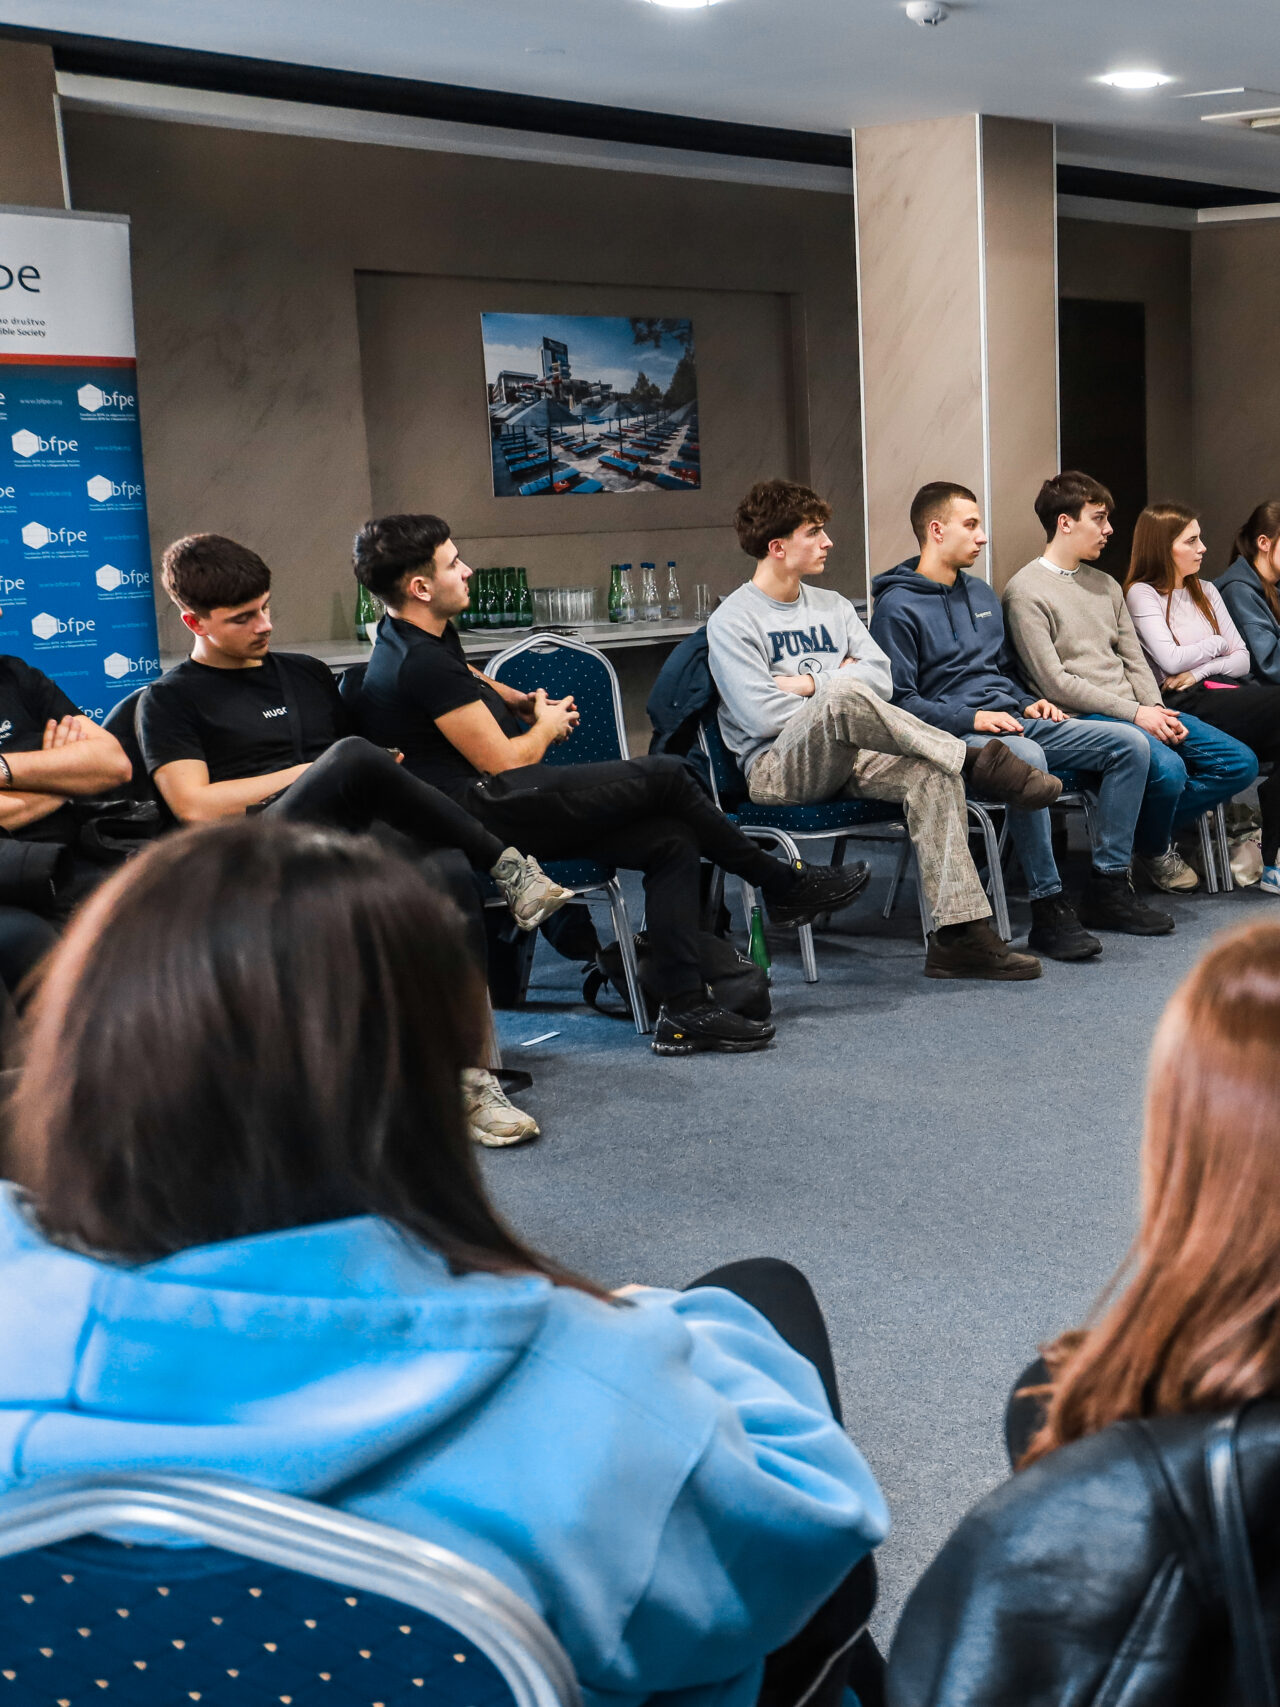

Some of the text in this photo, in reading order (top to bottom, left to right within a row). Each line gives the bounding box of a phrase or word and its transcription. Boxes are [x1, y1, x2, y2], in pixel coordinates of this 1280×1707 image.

[11, 317, 46, 326] društvo
[17, 328, 46, 337] Society
[102, 391, 135, 410] bfpe
[38, 436, 79, 455] bfpe
[111, 481, 142, 500] bfpe
[48, 527, 88, 546] bfpe
[120, 569, 150, 588] bfpe
[58, 617, 96, 636] bfpe
[766, 623, 839, 663] PUMA
[129, 656, 160, 675] bfpe
